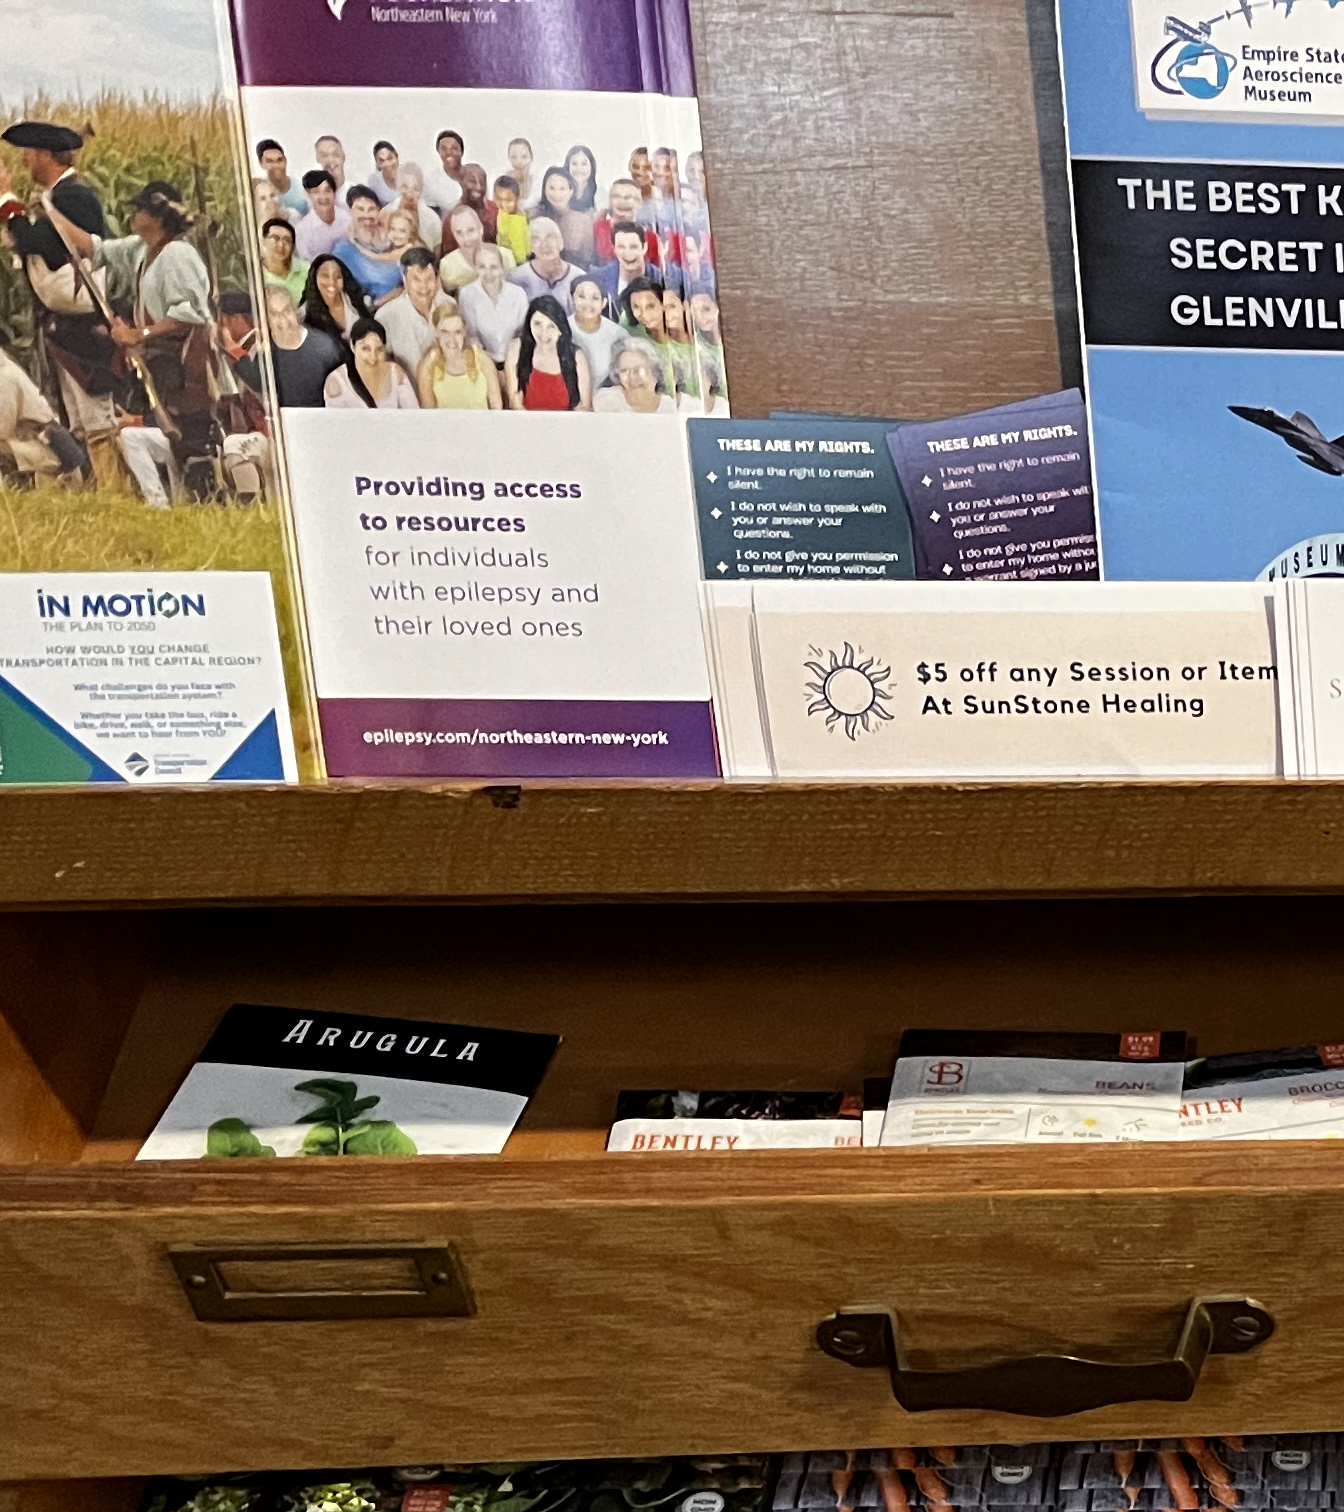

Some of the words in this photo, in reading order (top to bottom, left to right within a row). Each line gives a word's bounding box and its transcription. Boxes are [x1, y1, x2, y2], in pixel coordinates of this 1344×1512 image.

[371, 6, 443, 22] Northeastern
[445, 7, 470, 23] New
[473, 8, 498, 23] York
[1242, 46, 1299, 65] Empire
[1244, 85, 1312, 103] Museum
[1117, 178, 1196, 211] THE
[1208, 181, 1306, 215] BEST
[1169, 237, 1323, 272] SECRET
[717, 439, 761, 451] THESE
[765, 440, 792, 452] ARE
[795, 441, 814, 453] MY
[818, 441, 875, 454] RIGHTS.
[355, 476, 485, 500] Providing
[494, 481, 582, 498] access
[360, 513, 387, 530] to
[396, 515, 526, 532] resources
[365, 545, 400, 566] for
[410, 547, 549, 568] individuals
[369, 581, 424, 601] with
[434, 581, 541, 605] epilepsy
[551, 584, 599, 603] and
[43, 622, 65, 632] THE
[70, 622, 103, 632] PLAN
[107, 622, 124, 631] TO
[127, 622, 156, 632] 2050
[374, 616, 433, 635] their
[442, 616, 512, 636] loved
[522, 620, 582, 637] ones
[917, 663, 948, 686] $5
[960, 662, 998, 683] off
[1009, 665, 1056, 686] any
[1070, 661, 1170, 683] Session
[1181, 665, 1208, 681] or
[1219, 662, 1279, 682] Item
[922, 696, 953, 715] At
[963, 695, 1090, 715] SunStone
[1103, 694, 1205, 717] Healing
[363, 729, 668, 746] epilepsy.com/northeastern-new-york
